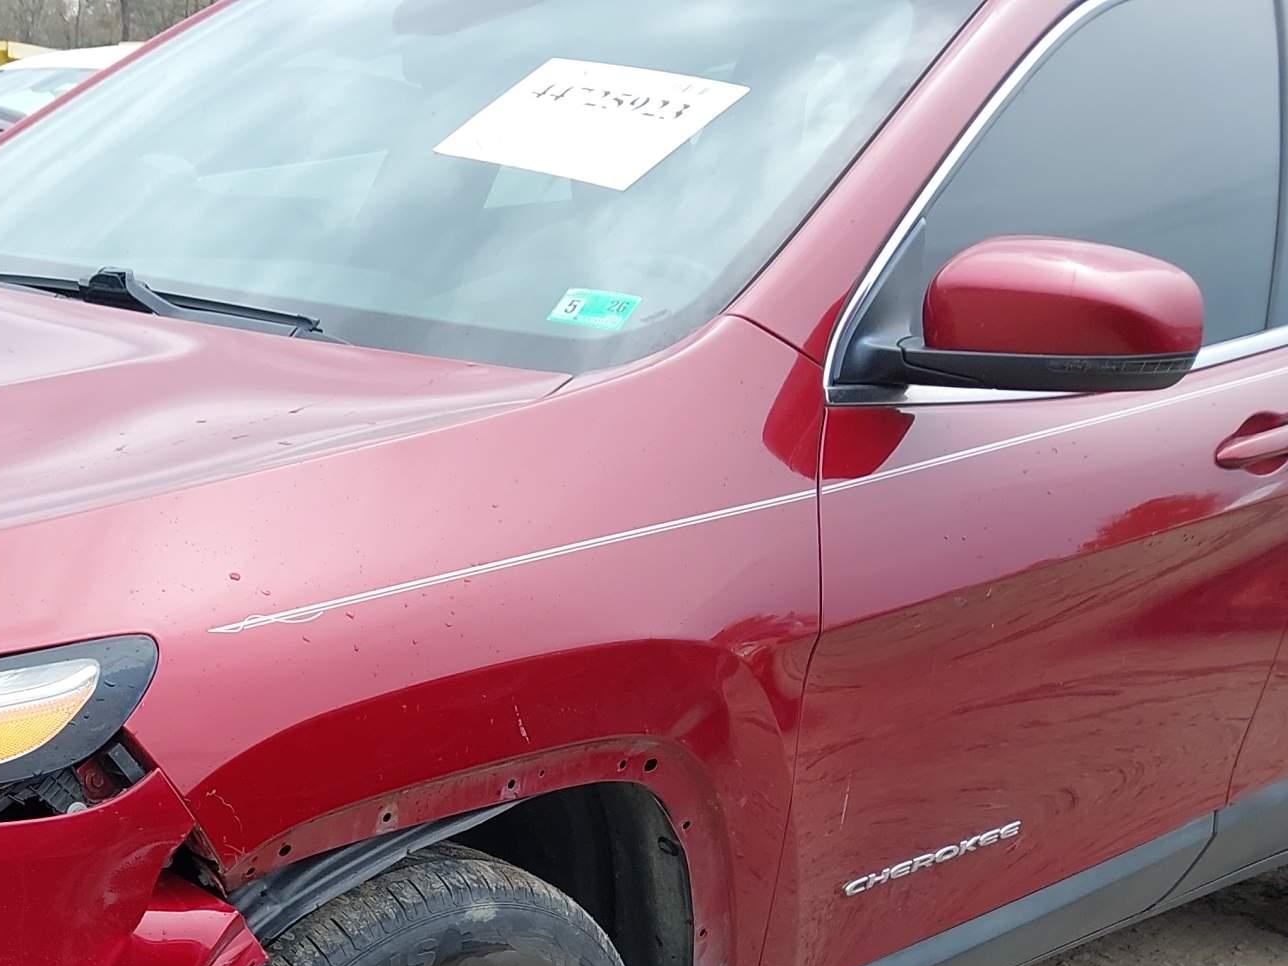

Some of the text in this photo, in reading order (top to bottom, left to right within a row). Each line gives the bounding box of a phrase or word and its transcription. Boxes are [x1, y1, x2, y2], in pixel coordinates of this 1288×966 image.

[564, 299, 630, 314] 5 26
[844, 820, 1021, 896] CHEROKEE
